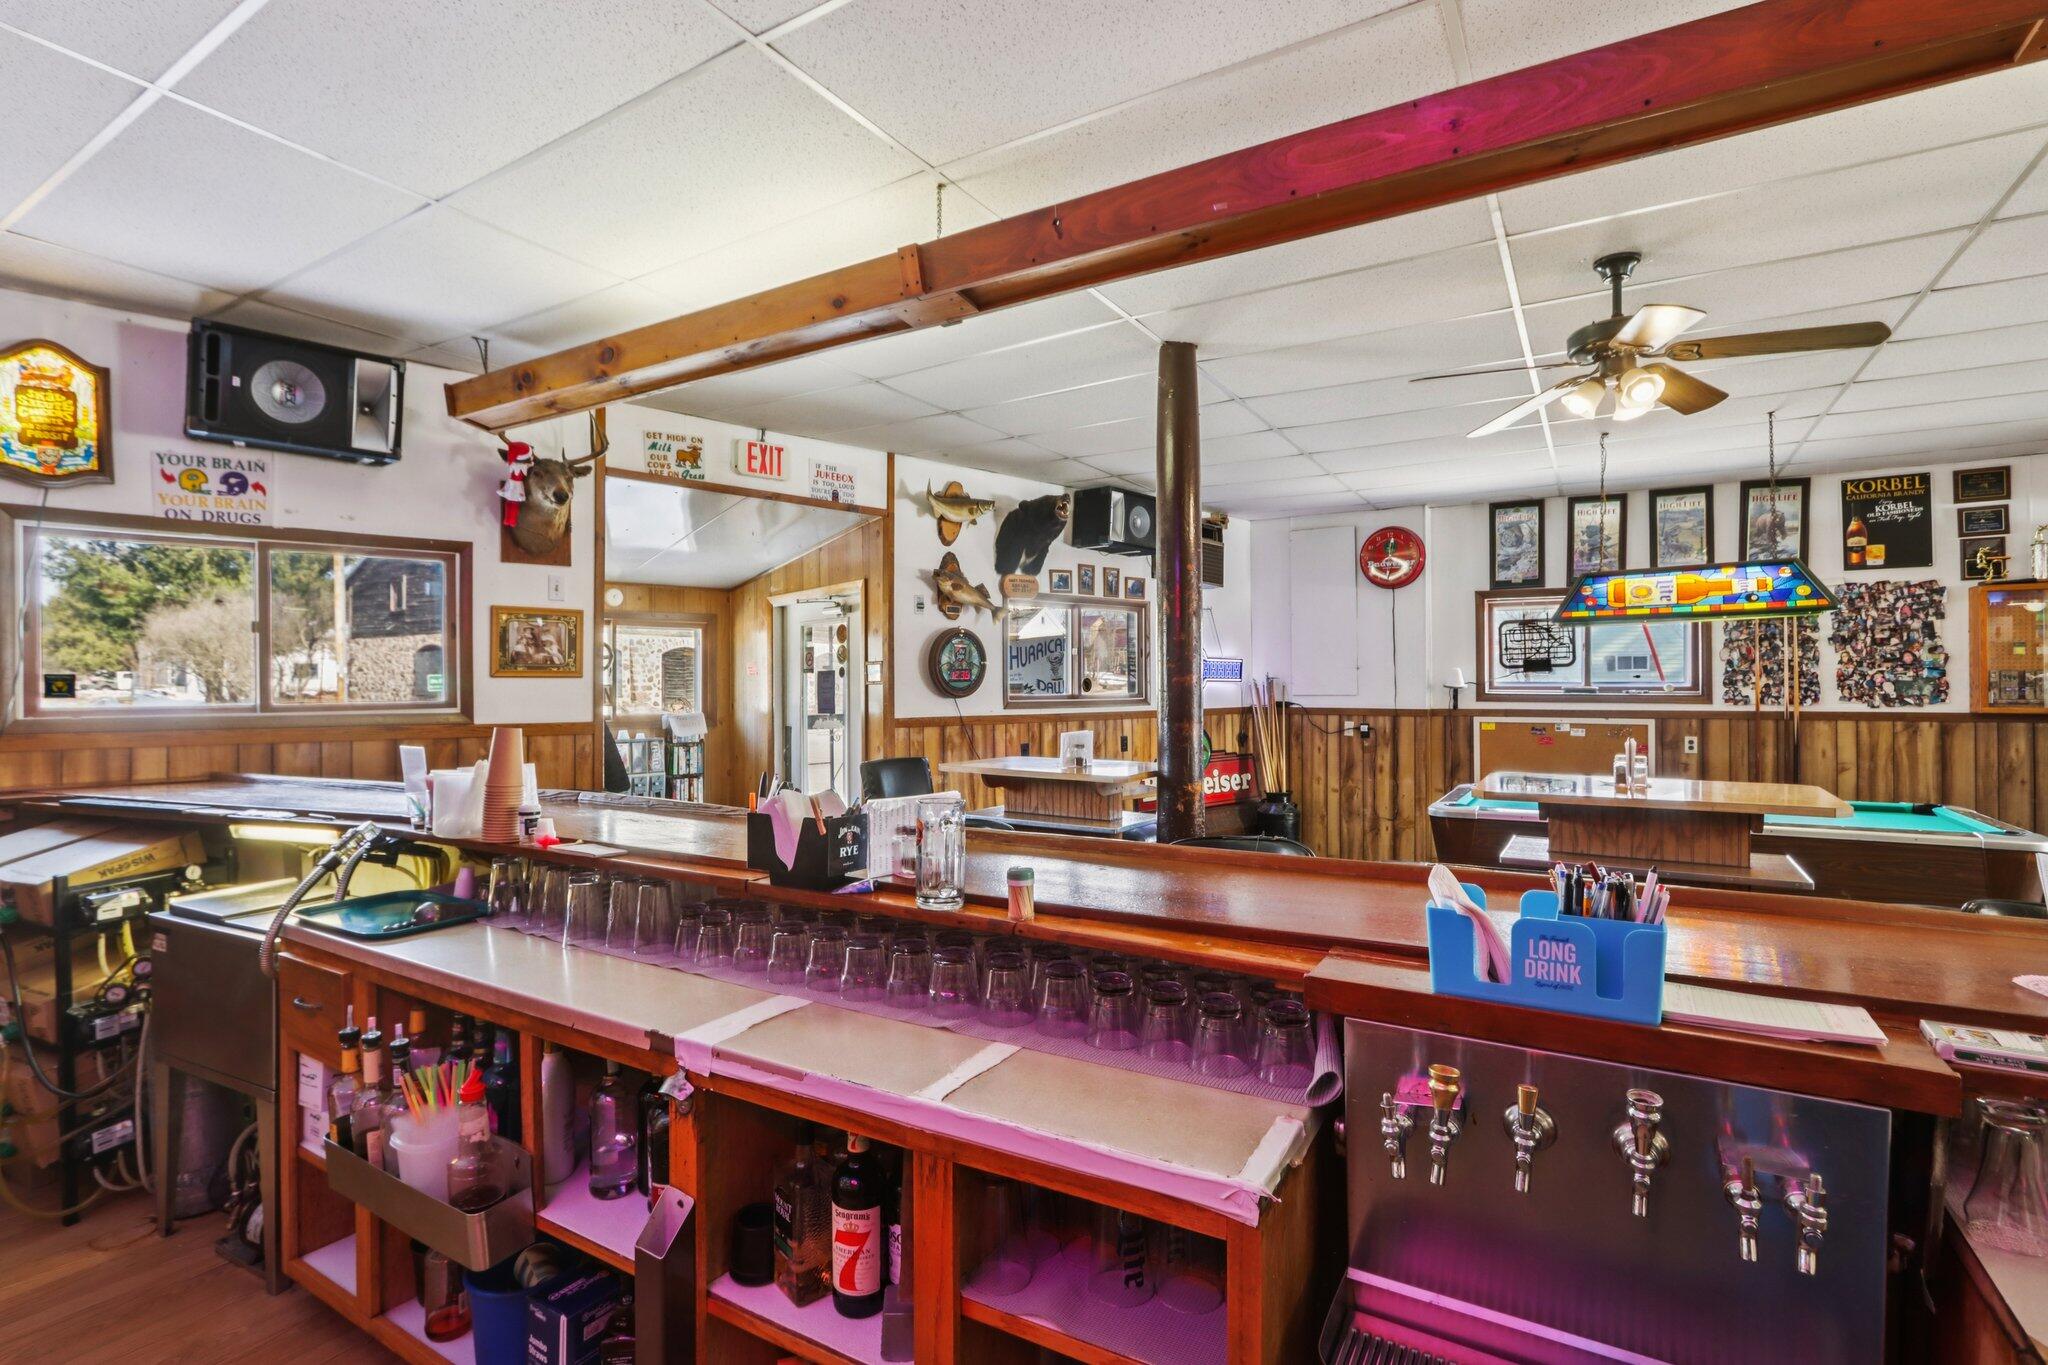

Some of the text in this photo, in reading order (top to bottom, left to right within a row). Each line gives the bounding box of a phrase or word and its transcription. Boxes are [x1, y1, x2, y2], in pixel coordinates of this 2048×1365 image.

[646, 431, 703, 444] GET HIGH ON
[648, 441, 671, 452] Milk
[156, 452, 266, 473] YOUR BRAIN
[650, 453, 668, 461] OUR
[747, 441, 784, 477] EXIT
[647, 461, 671, 469] COWS
[825, 464, 837, 472] THE
[815, 469, 854, 484] JUKEBOX
[822, 480, 835, 488] TOO
[838, 483, 855, 491] LOUD
[1846, 475, 1926, 495] KORBEL
[158, 492, 267, 511] YOUR BRAIN
[1752, 493, 1797, 502] HIG LIFE
[1846, 489, 1926, 501] CALIFORNIA BRANDY
[1577, 507, 1616, 517] HIGH IFE
[1659, 500, 1702, 509] HIGH LIFE
[1875, 501, 1914, 512] KORBEL
[164, 508, 262, 524] ON DRUGS
[1656, 578, 1674, 602] Lite
[1009, 637, 1065, 670] HURRICA
[1036, 678, 1065, 694] DAW
[1204, 768, 1252, 794] eiser
[840, 844, 859, 858] RYE
[1528, 938, 1576, 963] LONG
[1524, 958, 1582, 985] DRINK
[850, 1132, 859, 1150] 7
[834, 1229, 872, 1292] 7
